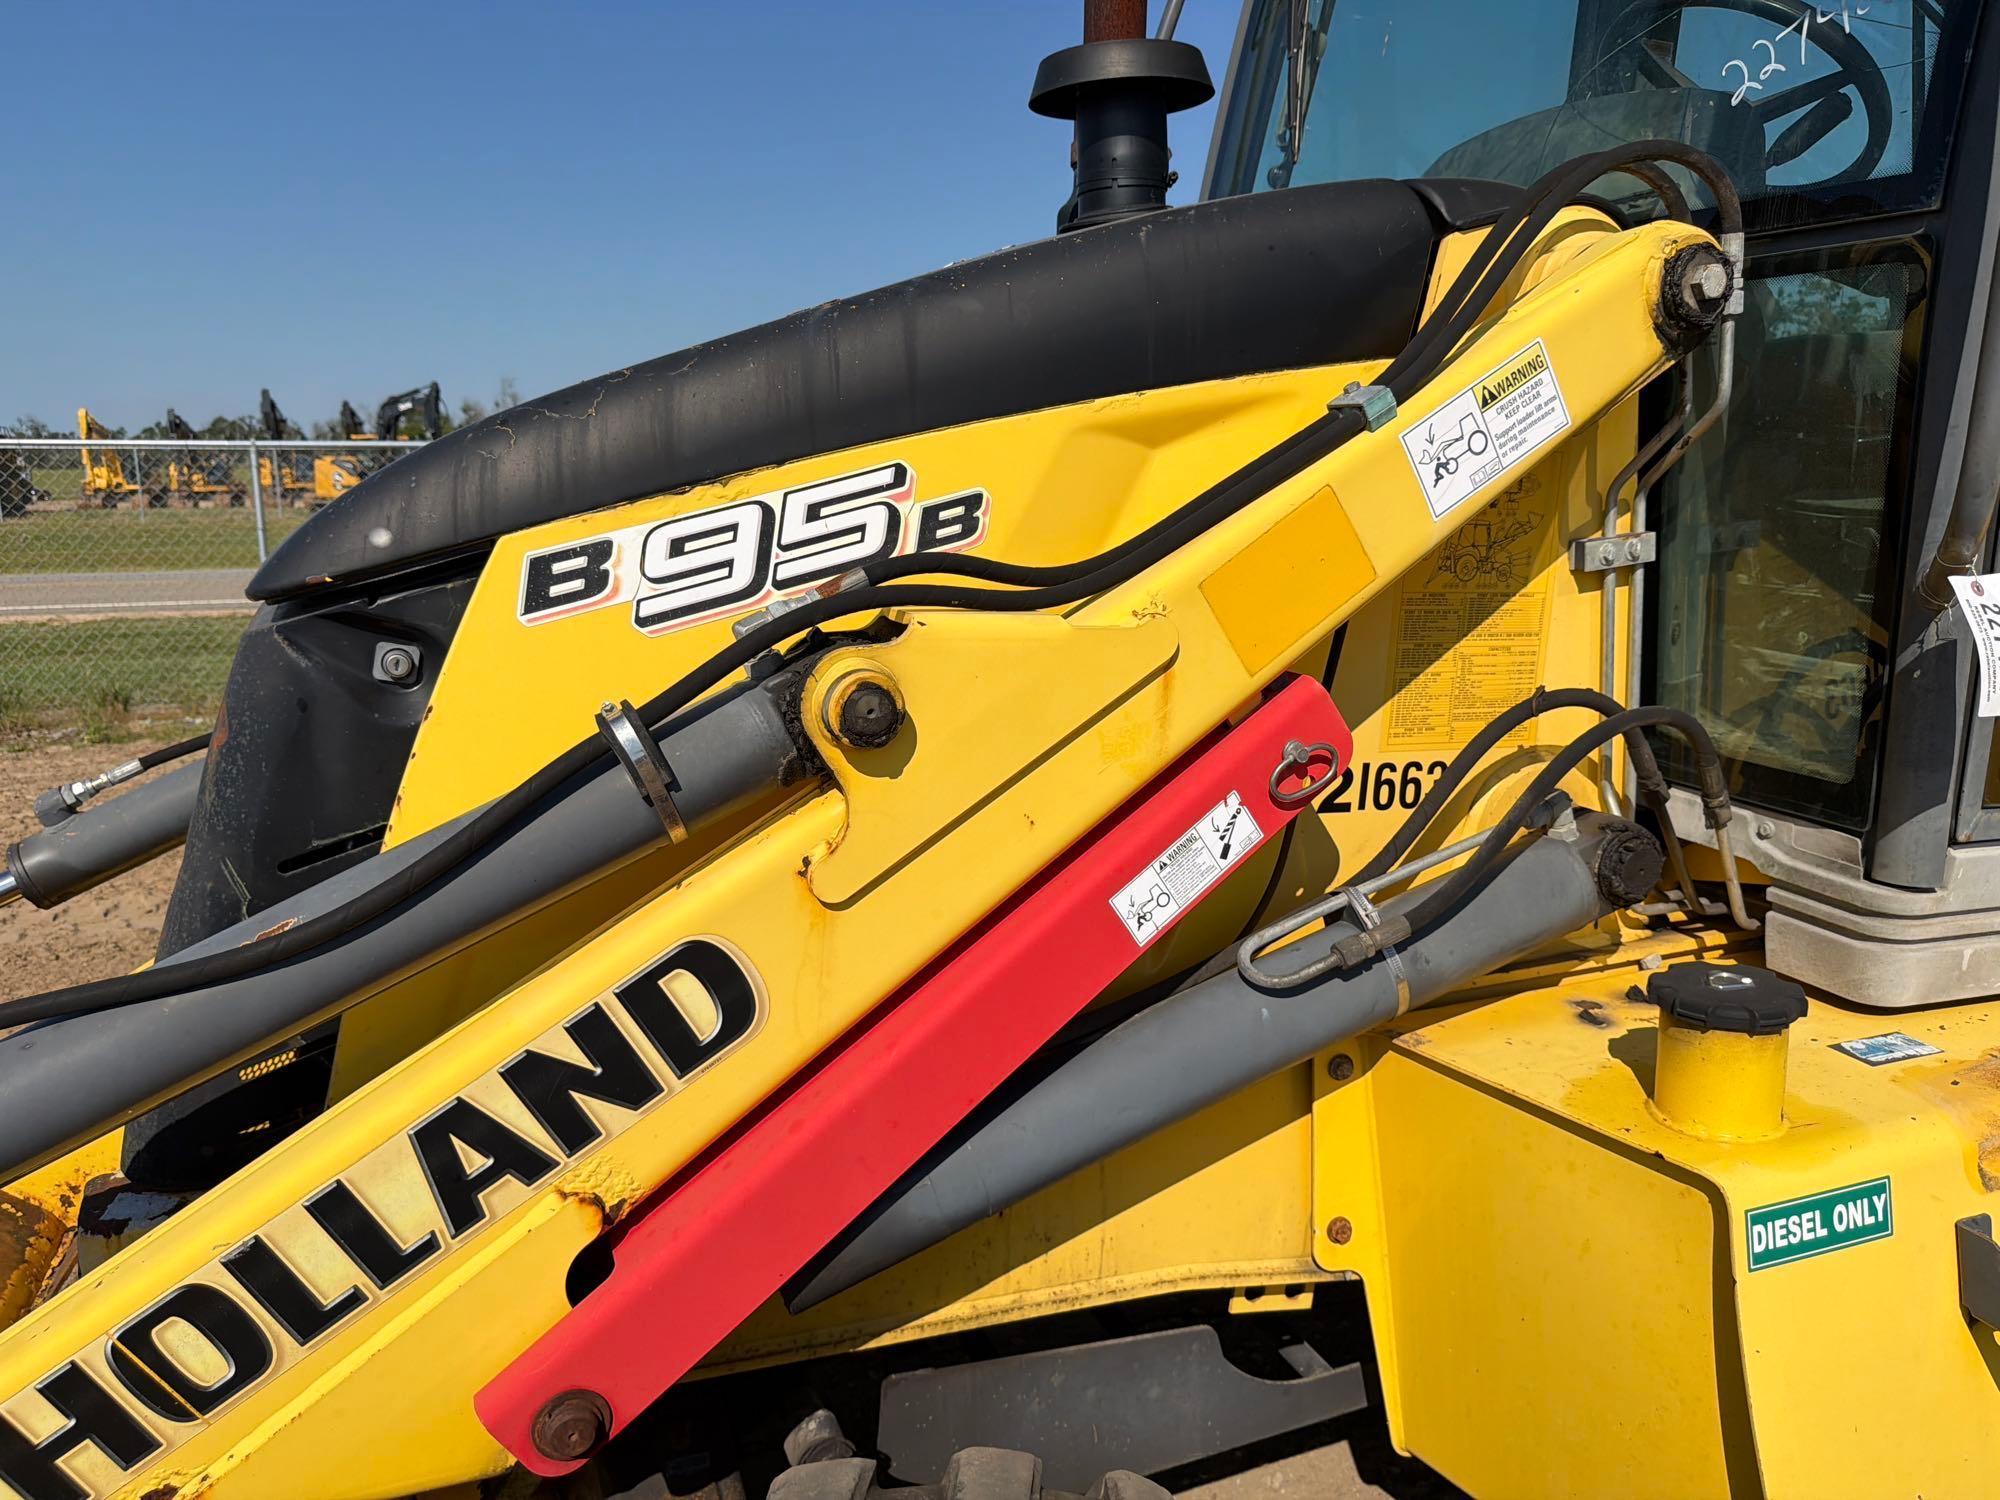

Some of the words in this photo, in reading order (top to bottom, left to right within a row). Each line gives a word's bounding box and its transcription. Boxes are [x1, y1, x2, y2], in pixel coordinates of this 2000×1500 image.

[1722, 0, 1871, 107] 2274
[1493, 354, 1545, 397] WARNING
[1496, 396, 1518, 415] CRUSH
[1518, 378, 1544, 399] HAZARD
[1494, 421, 1518, 441] Support
[1516, 409, 1535, 427] loader
[1534, 403, 1543, 414] lift
[1543, 395, 1558, 407] arms
[1504, 404, 1521, 420] KEEP
[1521, 390, 1542, 408] CLEAR
[1498, 433, 1518, 450] during
[1518, 406, 1556, 435] maintenance
[1984, 627, 1995, 658] AUCTION
[1166, 832, 1197, 861] WARNING
[0, 939, 757, 1500] HOLLAND
[1752, 1209, 1828, 1253] DIESEL
[1833, 1192, 1886, 1232] ONLY
